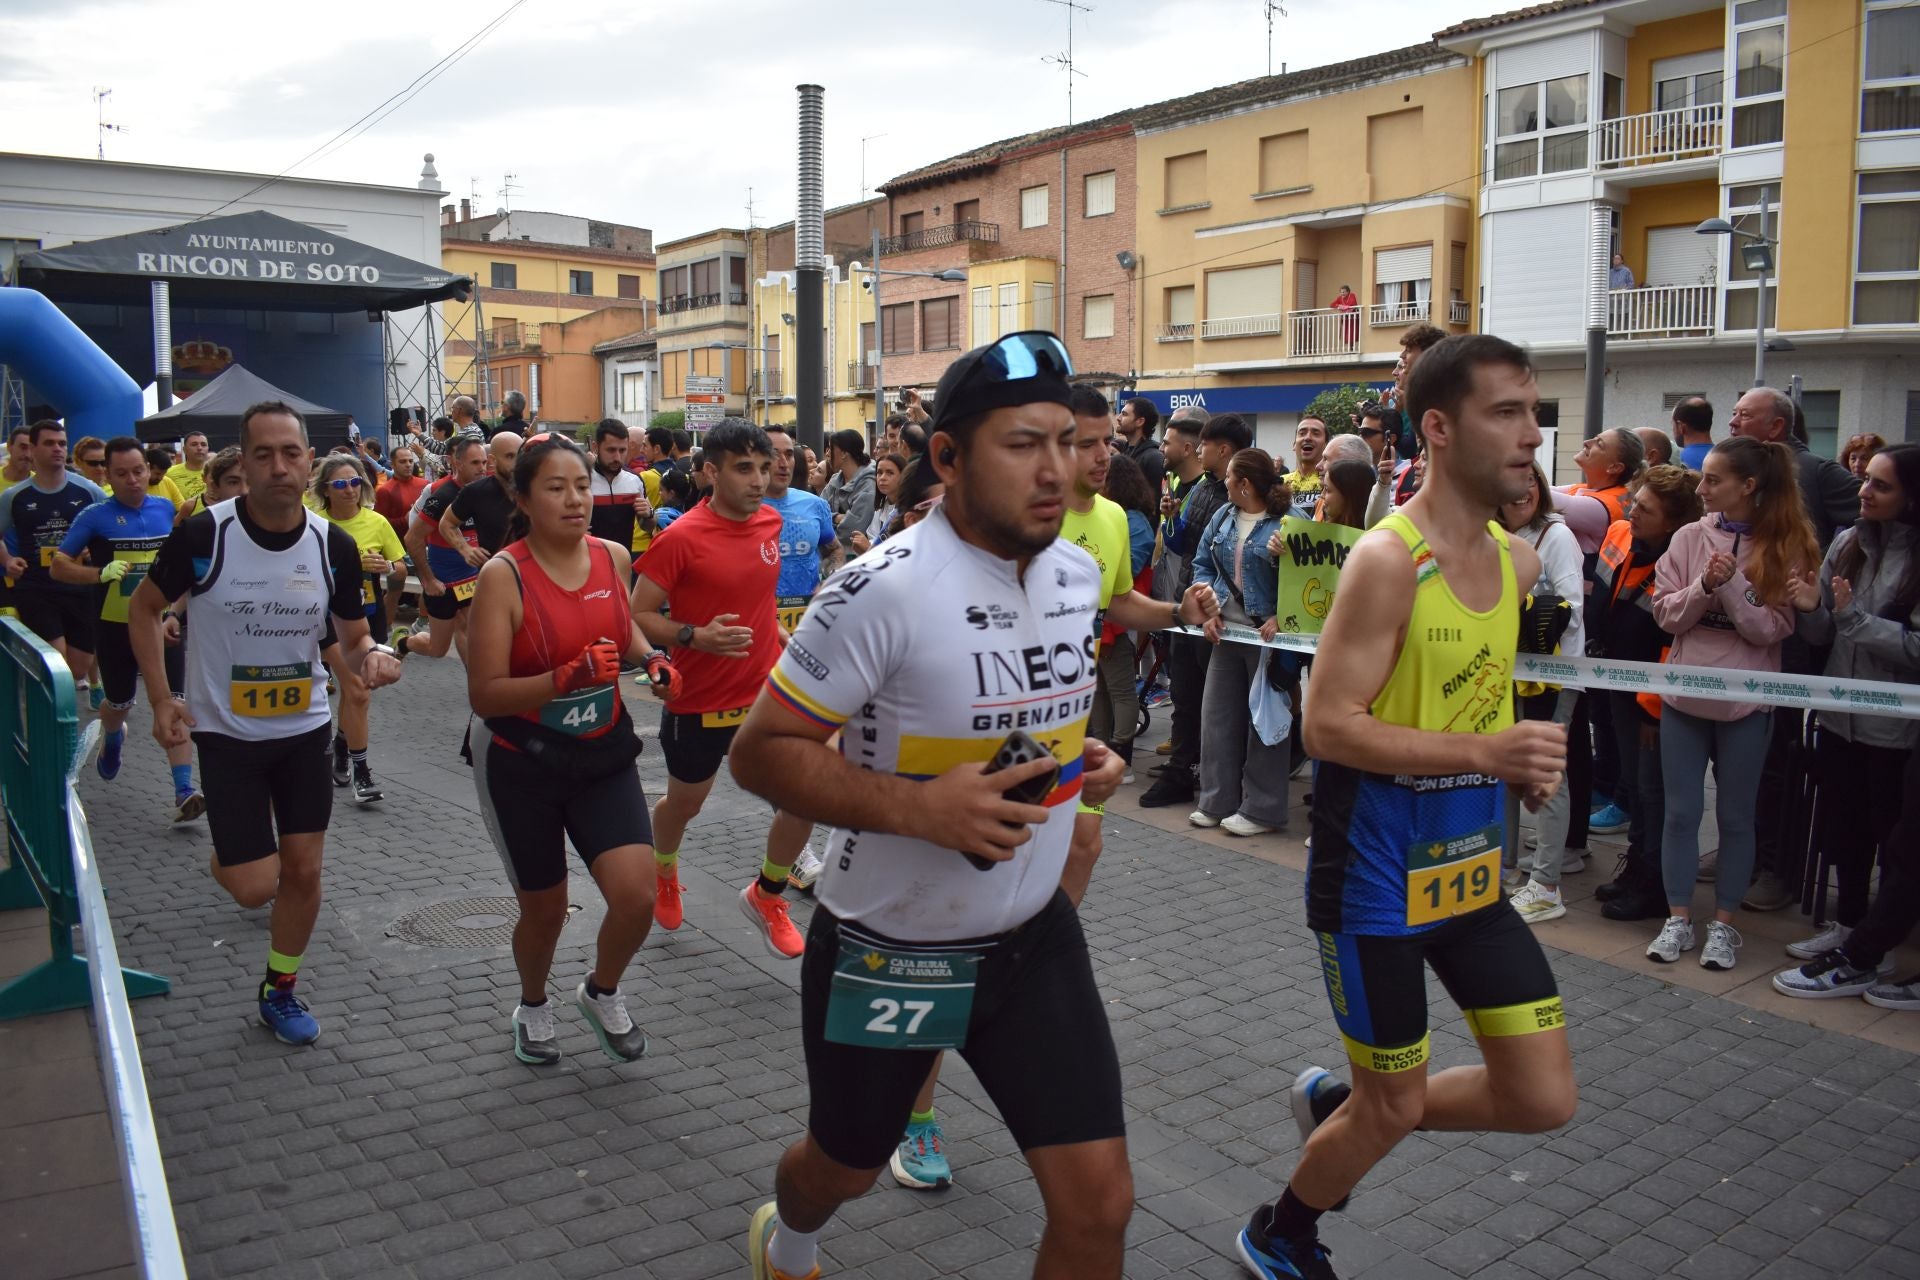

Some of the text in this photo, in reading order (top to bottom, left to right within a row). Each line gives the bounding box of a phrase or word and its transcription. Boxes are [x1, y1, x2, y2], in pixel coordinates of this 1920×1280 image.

[187, 233, 335, 256] AYUNTAMIENTO
[137, 252, 380, 284] RINCON DE SOTO
[1170, 392, 1206, 409] BBVA
[814, 546, 912, 632] INEOS
[262, 601, 300, 616] Vino
[305, 602, 321, 616] de
[991, 611, 1019, 620] WORLD
[994, 621, 1014, 629] TEAM
[970, 634, 1097, 697] INEOS
[1441, 642, 1492, 700] RINCON
[1556, 663, 1576, 671] RURAL
[1549, 667, 1578, 677] NAVARRA
[1608, 667, 1647, 677] CAJA RURAL
[1619, 675, 1650, 683] NAVARRA
[1682, 674, 1724, 684] CAJA RURAL
[1693, 681, 1727, 691] NAVARRA
[1763, 681, 1808, 691] CAJA RURAL
[243, 686, 302, 709] 118
[1763, 687, 1811, 698] DE NAVARRA
[1850, 689, 1897, 700] CAJA RURAL
[1862, 697, 1902, 707] NAVARRA
[562, 702, 598, 727] 44
[1439, 776, 1455, 789] DE
[1423, 864, 1490, 909] 119
[890, 957, 950, 969] CAJA RURAL
[889, 967, 953, 977] DE NAVARRA
[865, 998, 935, 1034] 27
[1538, 1016, 1554, 1028] DE
[1372, 1046, 1423, 1062] RINCÓN
[1374, 1054, 1423, 1071] DE SOTO
